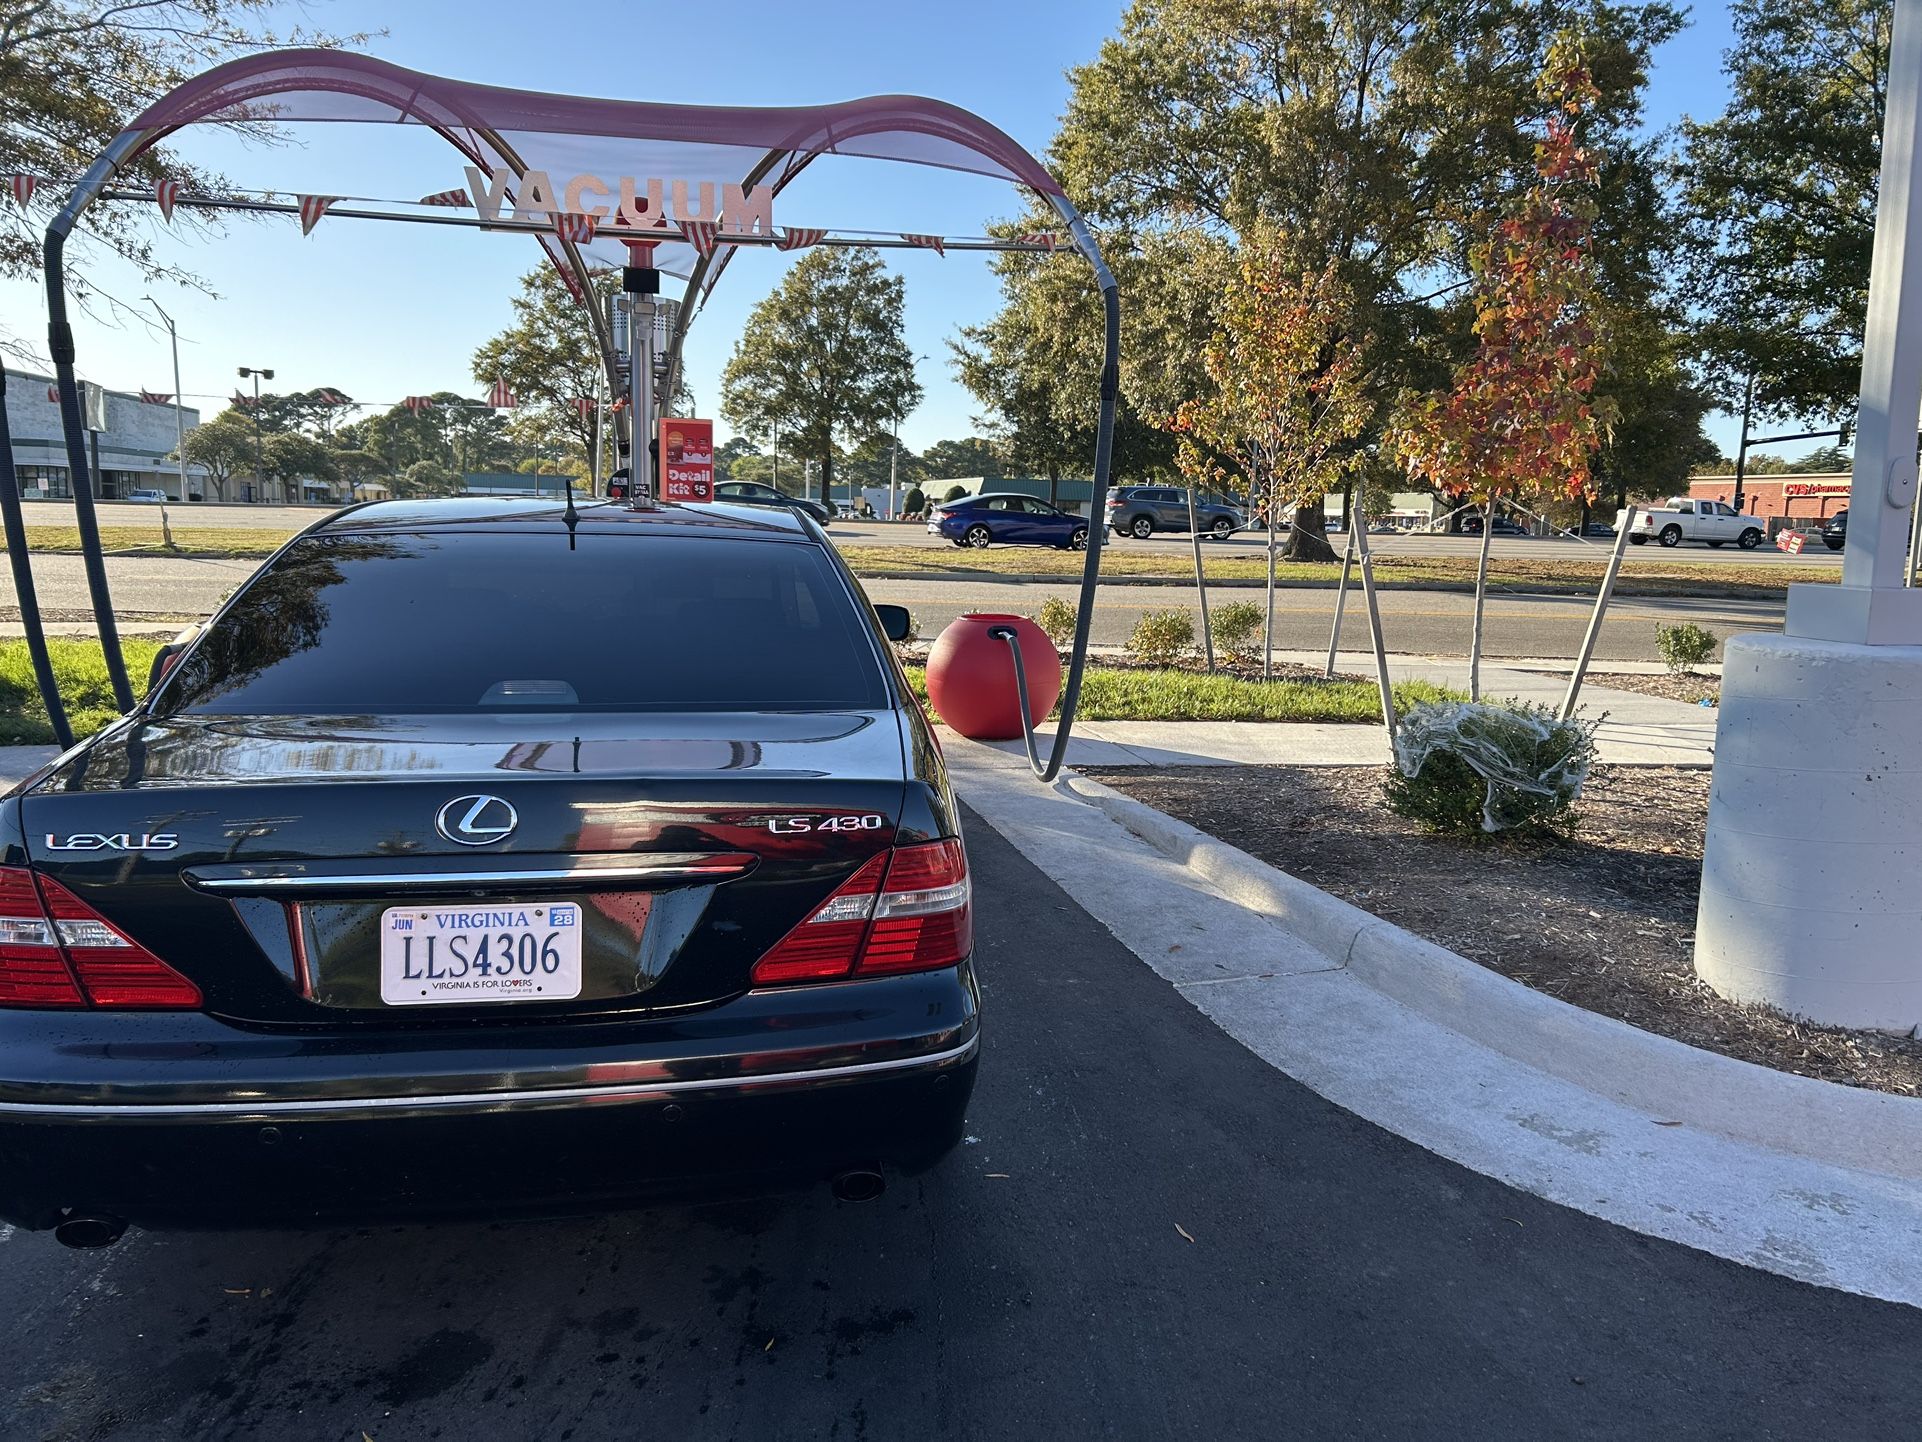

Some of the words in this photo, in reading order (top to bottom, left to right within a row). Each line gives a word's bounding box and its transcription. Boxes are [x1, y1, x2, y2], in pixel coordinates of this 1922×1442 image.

[463, 165, 773, 236] VACUUM
[668, 469, 711, 482] Detail
[668, 483, 690, 495] Kit
[694, 484, 707, 495] $5
[768, 818, 812, 834] LS
[817, 814, 882, 832] 430
[45, 833, 179, 850] LEXUS
[391, 919, 413, 930] JUN
[435, 911, 530, 929] VIRGINIA
[554, 915, 573, 925] 28
[402, 931, 560, 980] LLS4306
[432, 981, 471, 990] VIRGINIA
[482, 980, 499, 988] FOR
